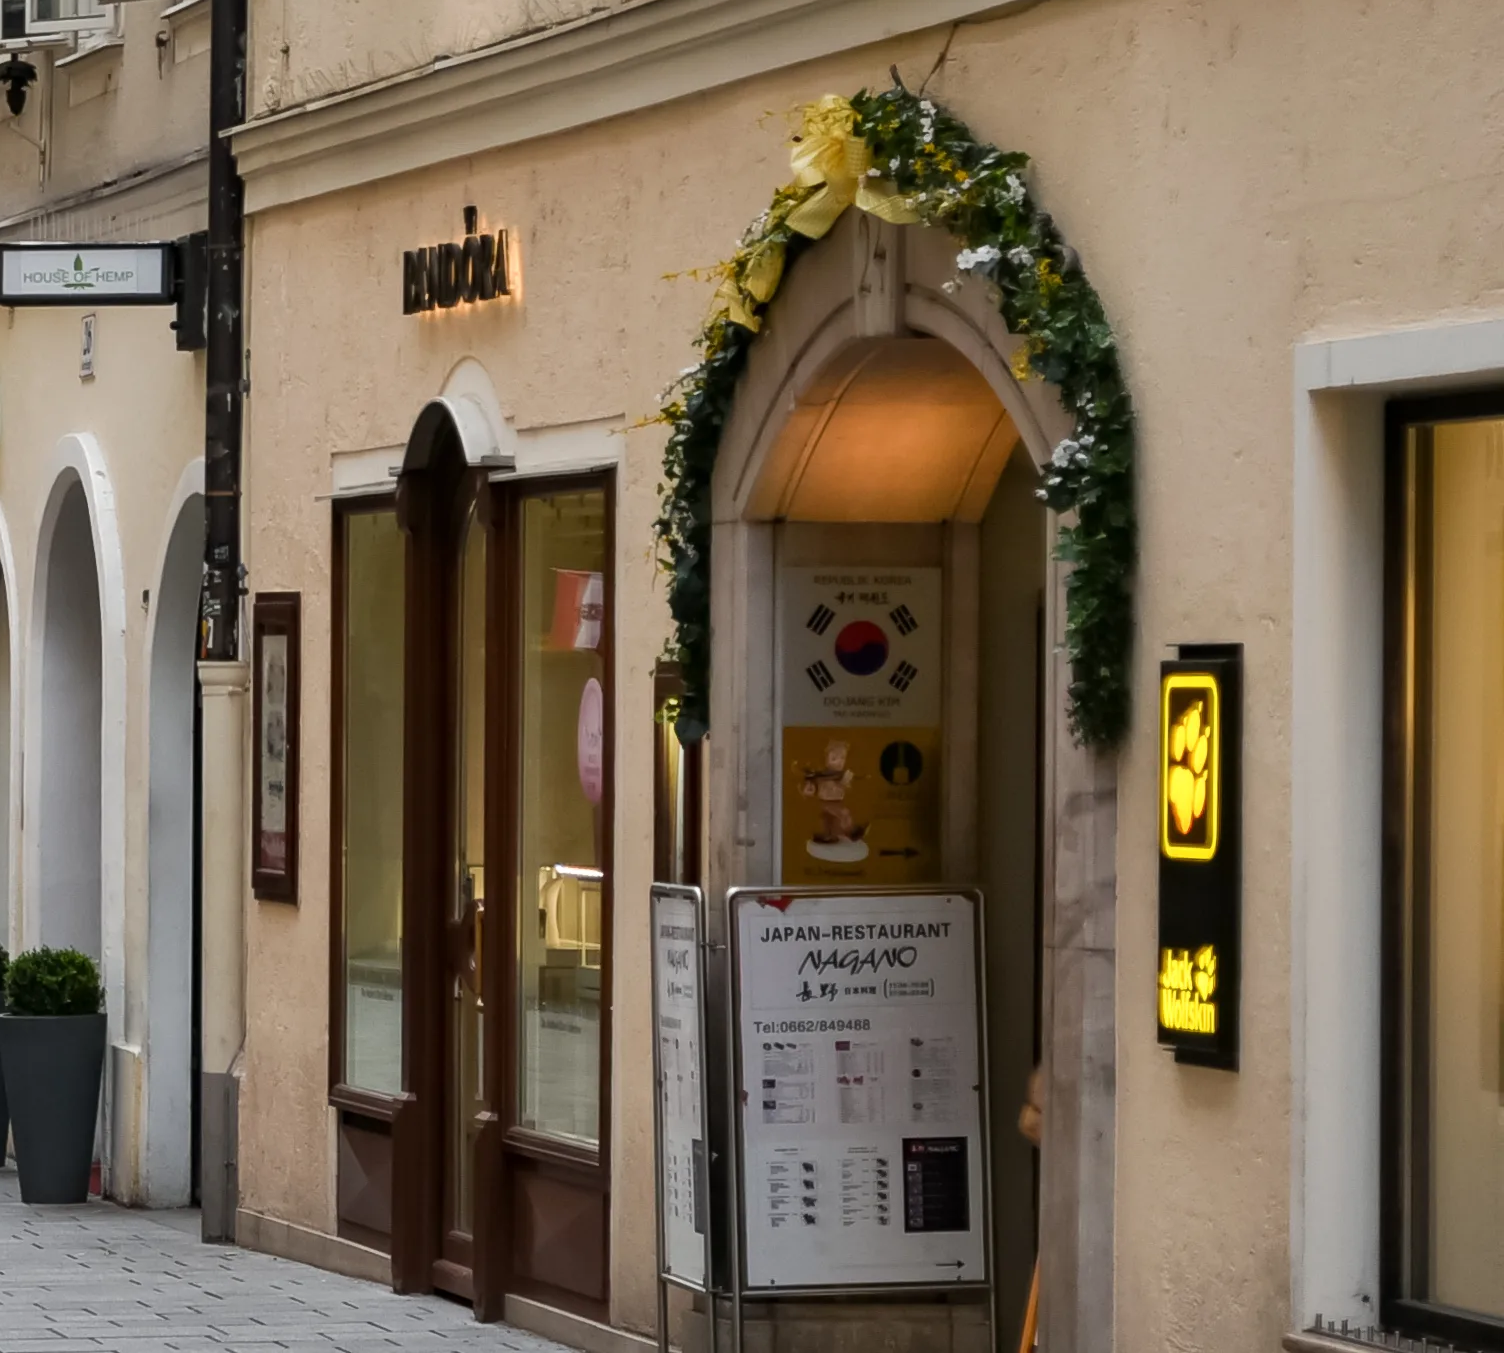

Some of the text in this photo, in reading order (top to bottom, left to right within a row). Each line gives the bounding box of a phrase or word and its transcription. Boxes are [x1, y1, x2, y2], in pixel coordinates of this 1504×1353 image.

[23, 270, 134, 284] HOUSE OF HEMP
[760, 922, 952, 943] JAPAN-RESTAURANT
[797, 946, 918, 976] NAGANO
[1160, 949, 1194, 991] Jack
